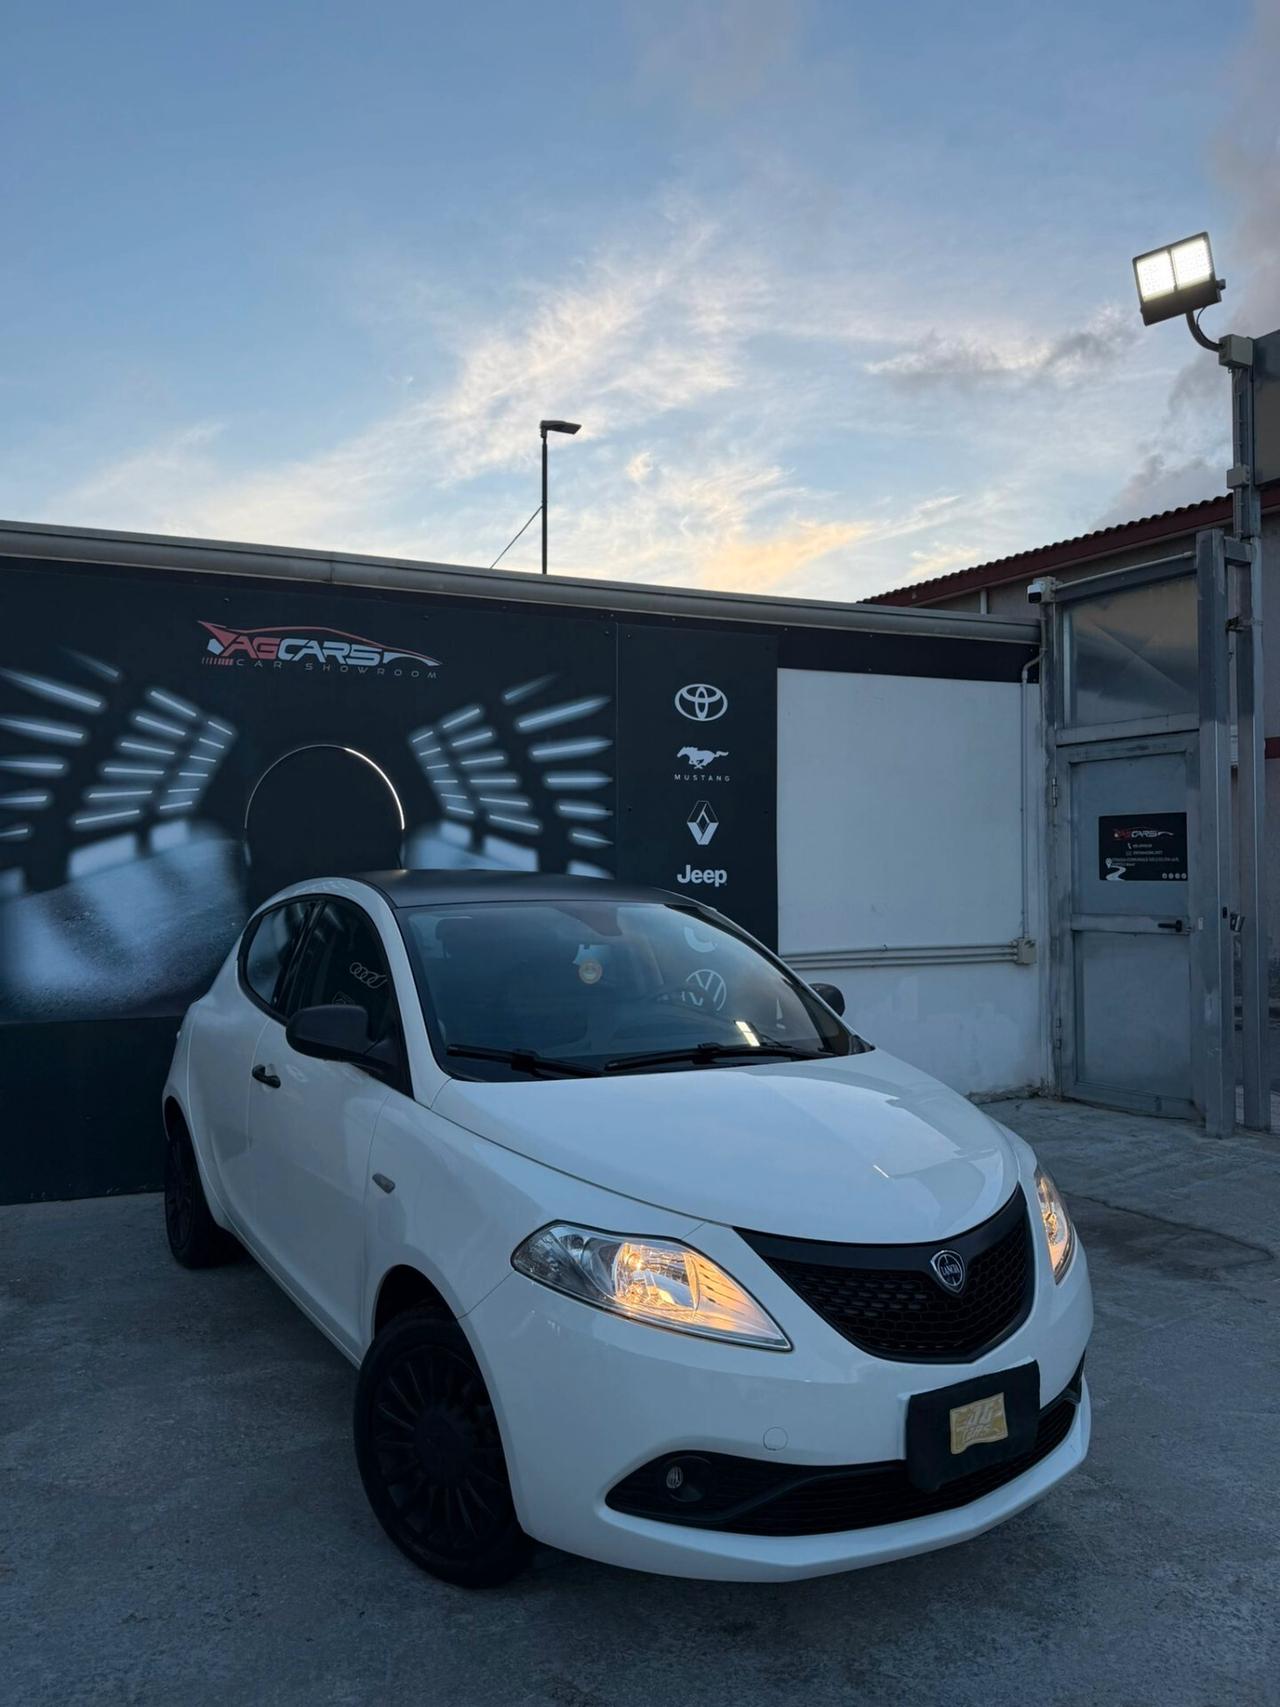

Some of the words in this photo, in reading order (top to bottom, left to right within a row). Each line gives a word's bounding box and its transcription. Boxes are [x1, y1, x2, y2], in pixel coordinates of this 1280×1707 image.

[236, 659, 282, 669] CAR
[304, 662, 437, 679] SHOWROOM
[674, 774, 730, 782] MUSTANG
[677, 864, 727, 887] Jeep
